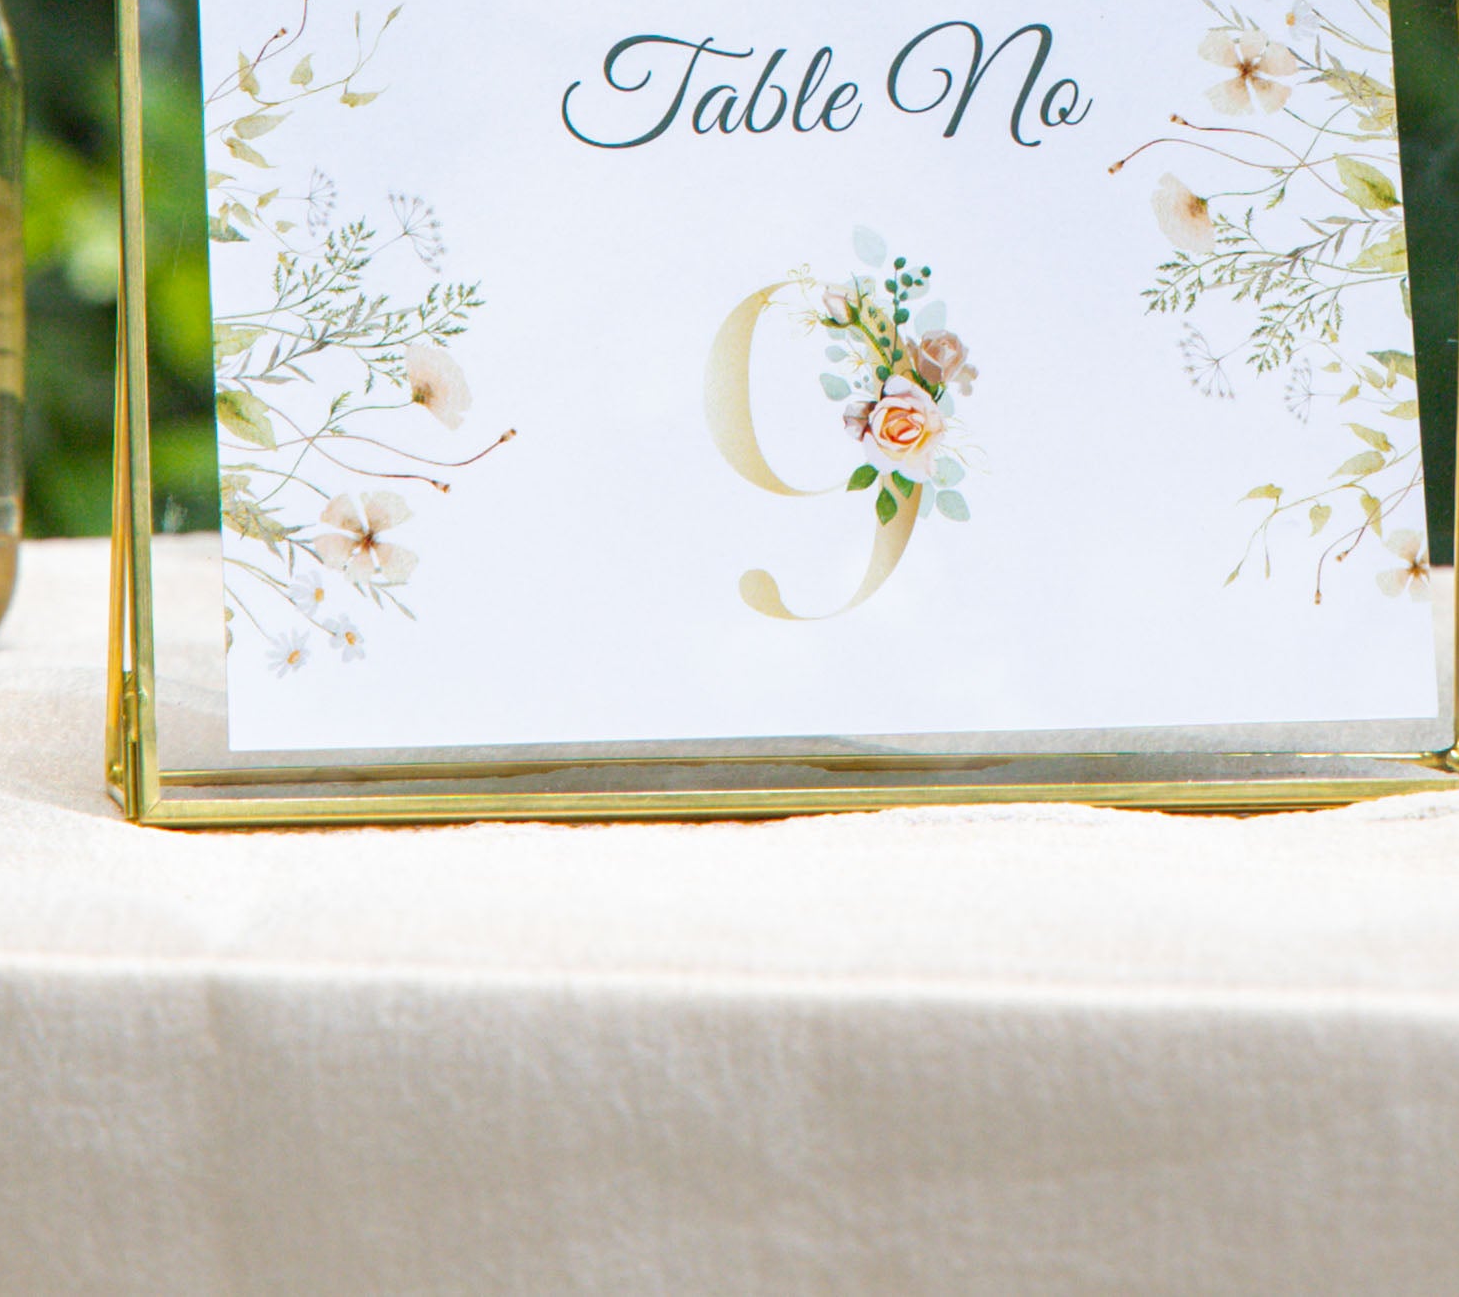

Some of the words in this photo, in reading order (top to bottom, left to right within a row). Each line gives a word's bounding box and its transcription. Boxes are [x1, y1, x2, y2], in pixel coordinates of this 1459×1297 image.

[562, 34, 863, 149] Table
[887, 20, 1093, 147] No
[703, 277, 926, 622] 9
